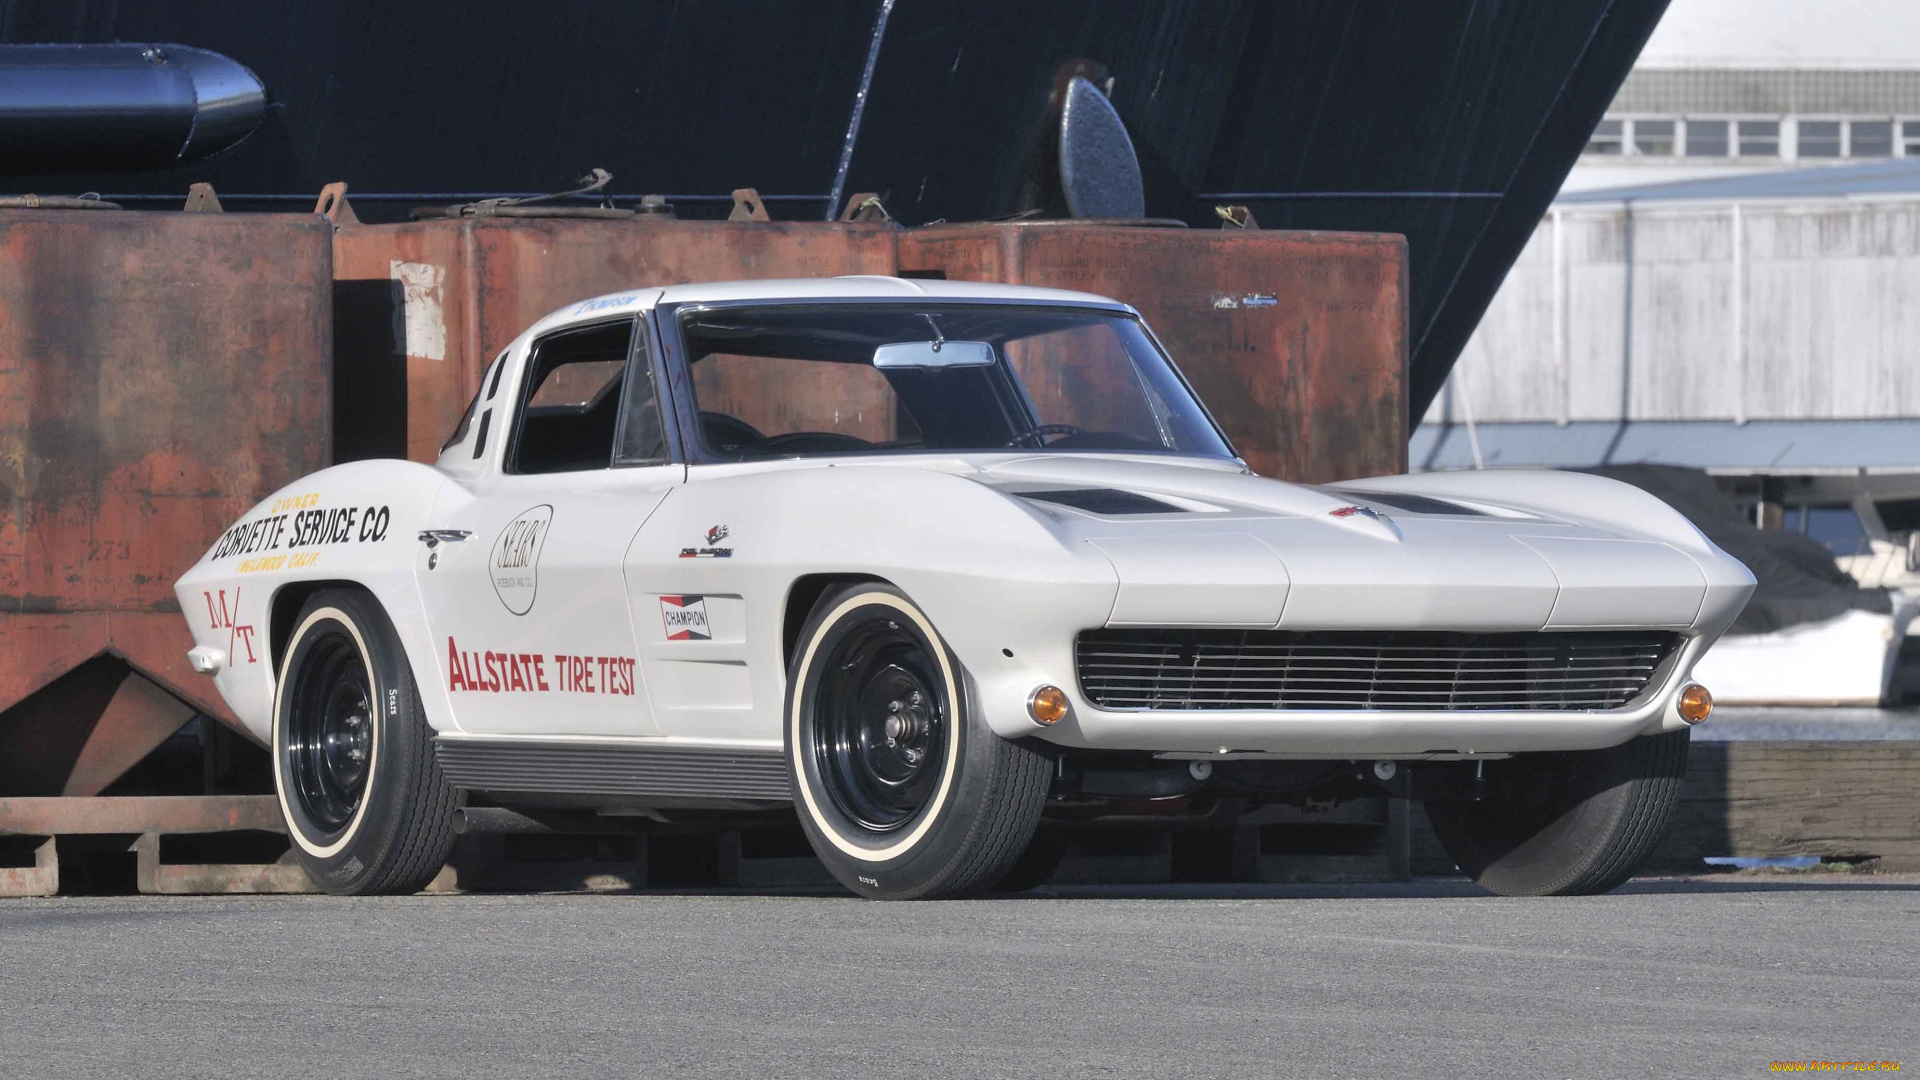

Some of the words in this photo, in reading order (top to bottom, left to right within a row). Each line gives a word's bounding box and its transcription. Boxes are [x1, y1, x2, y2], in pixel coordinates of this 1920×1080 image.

[271, 493, 320, 514] OWNER
[212, 514, 288, 561] CORVETTE
[288, 508, 358, 548] SERVICE
[359, 505, 390, 543] CO.
[497, 520, 547, 569] SEARS
[234, 554, 287, 574] INGLEWOOD
[665, 611, 706, 626] CHAMPION
[448, 635, 550, 694] ALLSTATE
[554, 654, 596, 694] TIRE
[597, 655, 636, 697] TEST
[388, 688, 398, 716] Sears
